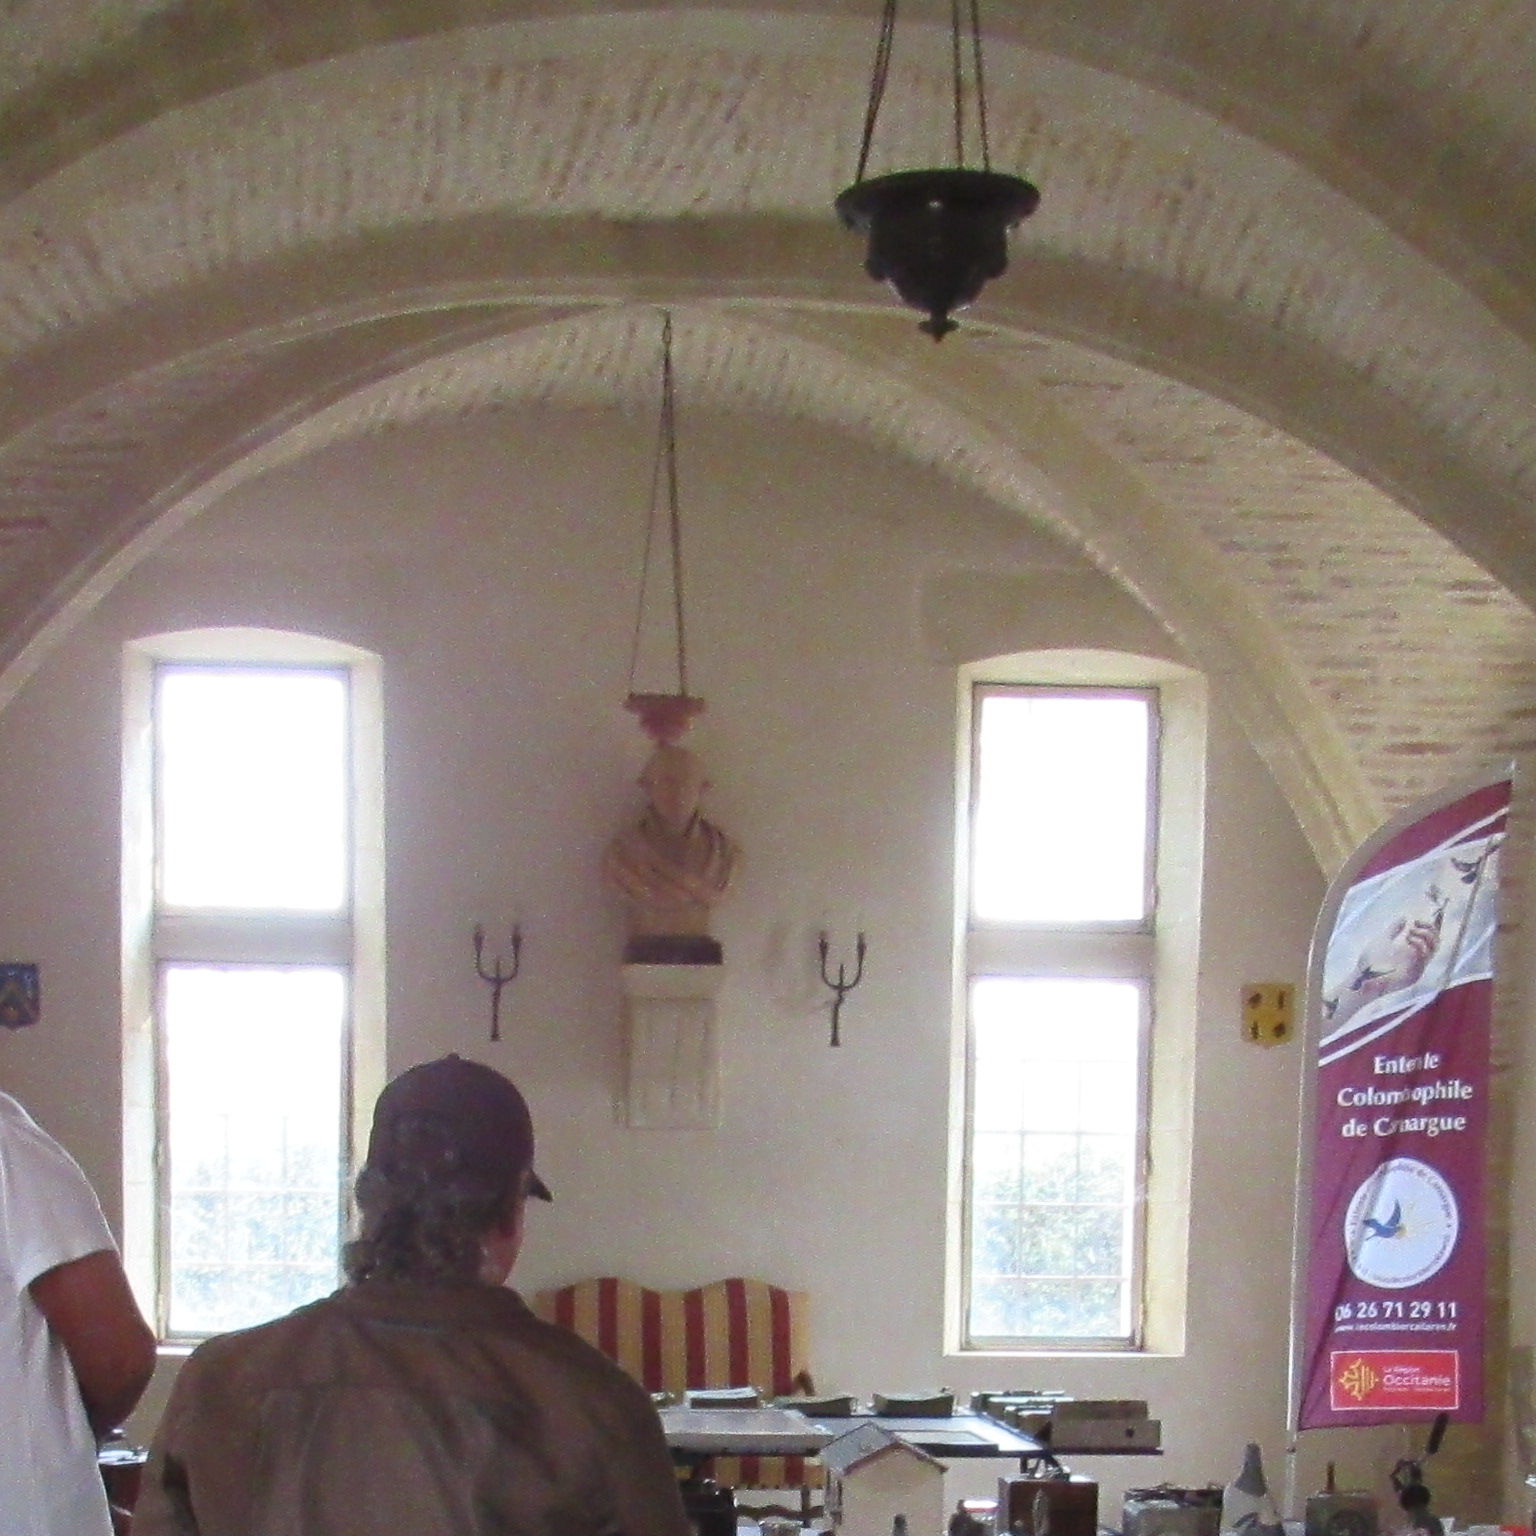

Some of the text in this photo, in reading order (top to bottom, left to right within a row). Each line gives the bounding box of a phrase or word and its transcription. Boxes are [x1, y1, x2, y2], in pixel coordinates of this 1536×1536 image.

[1341, 1118, 1368, 1137] de
[1335, 1301, 1457, 1321] 06 26 71 29 11
[1383, 1374, 1451, 1387] Occitanie
